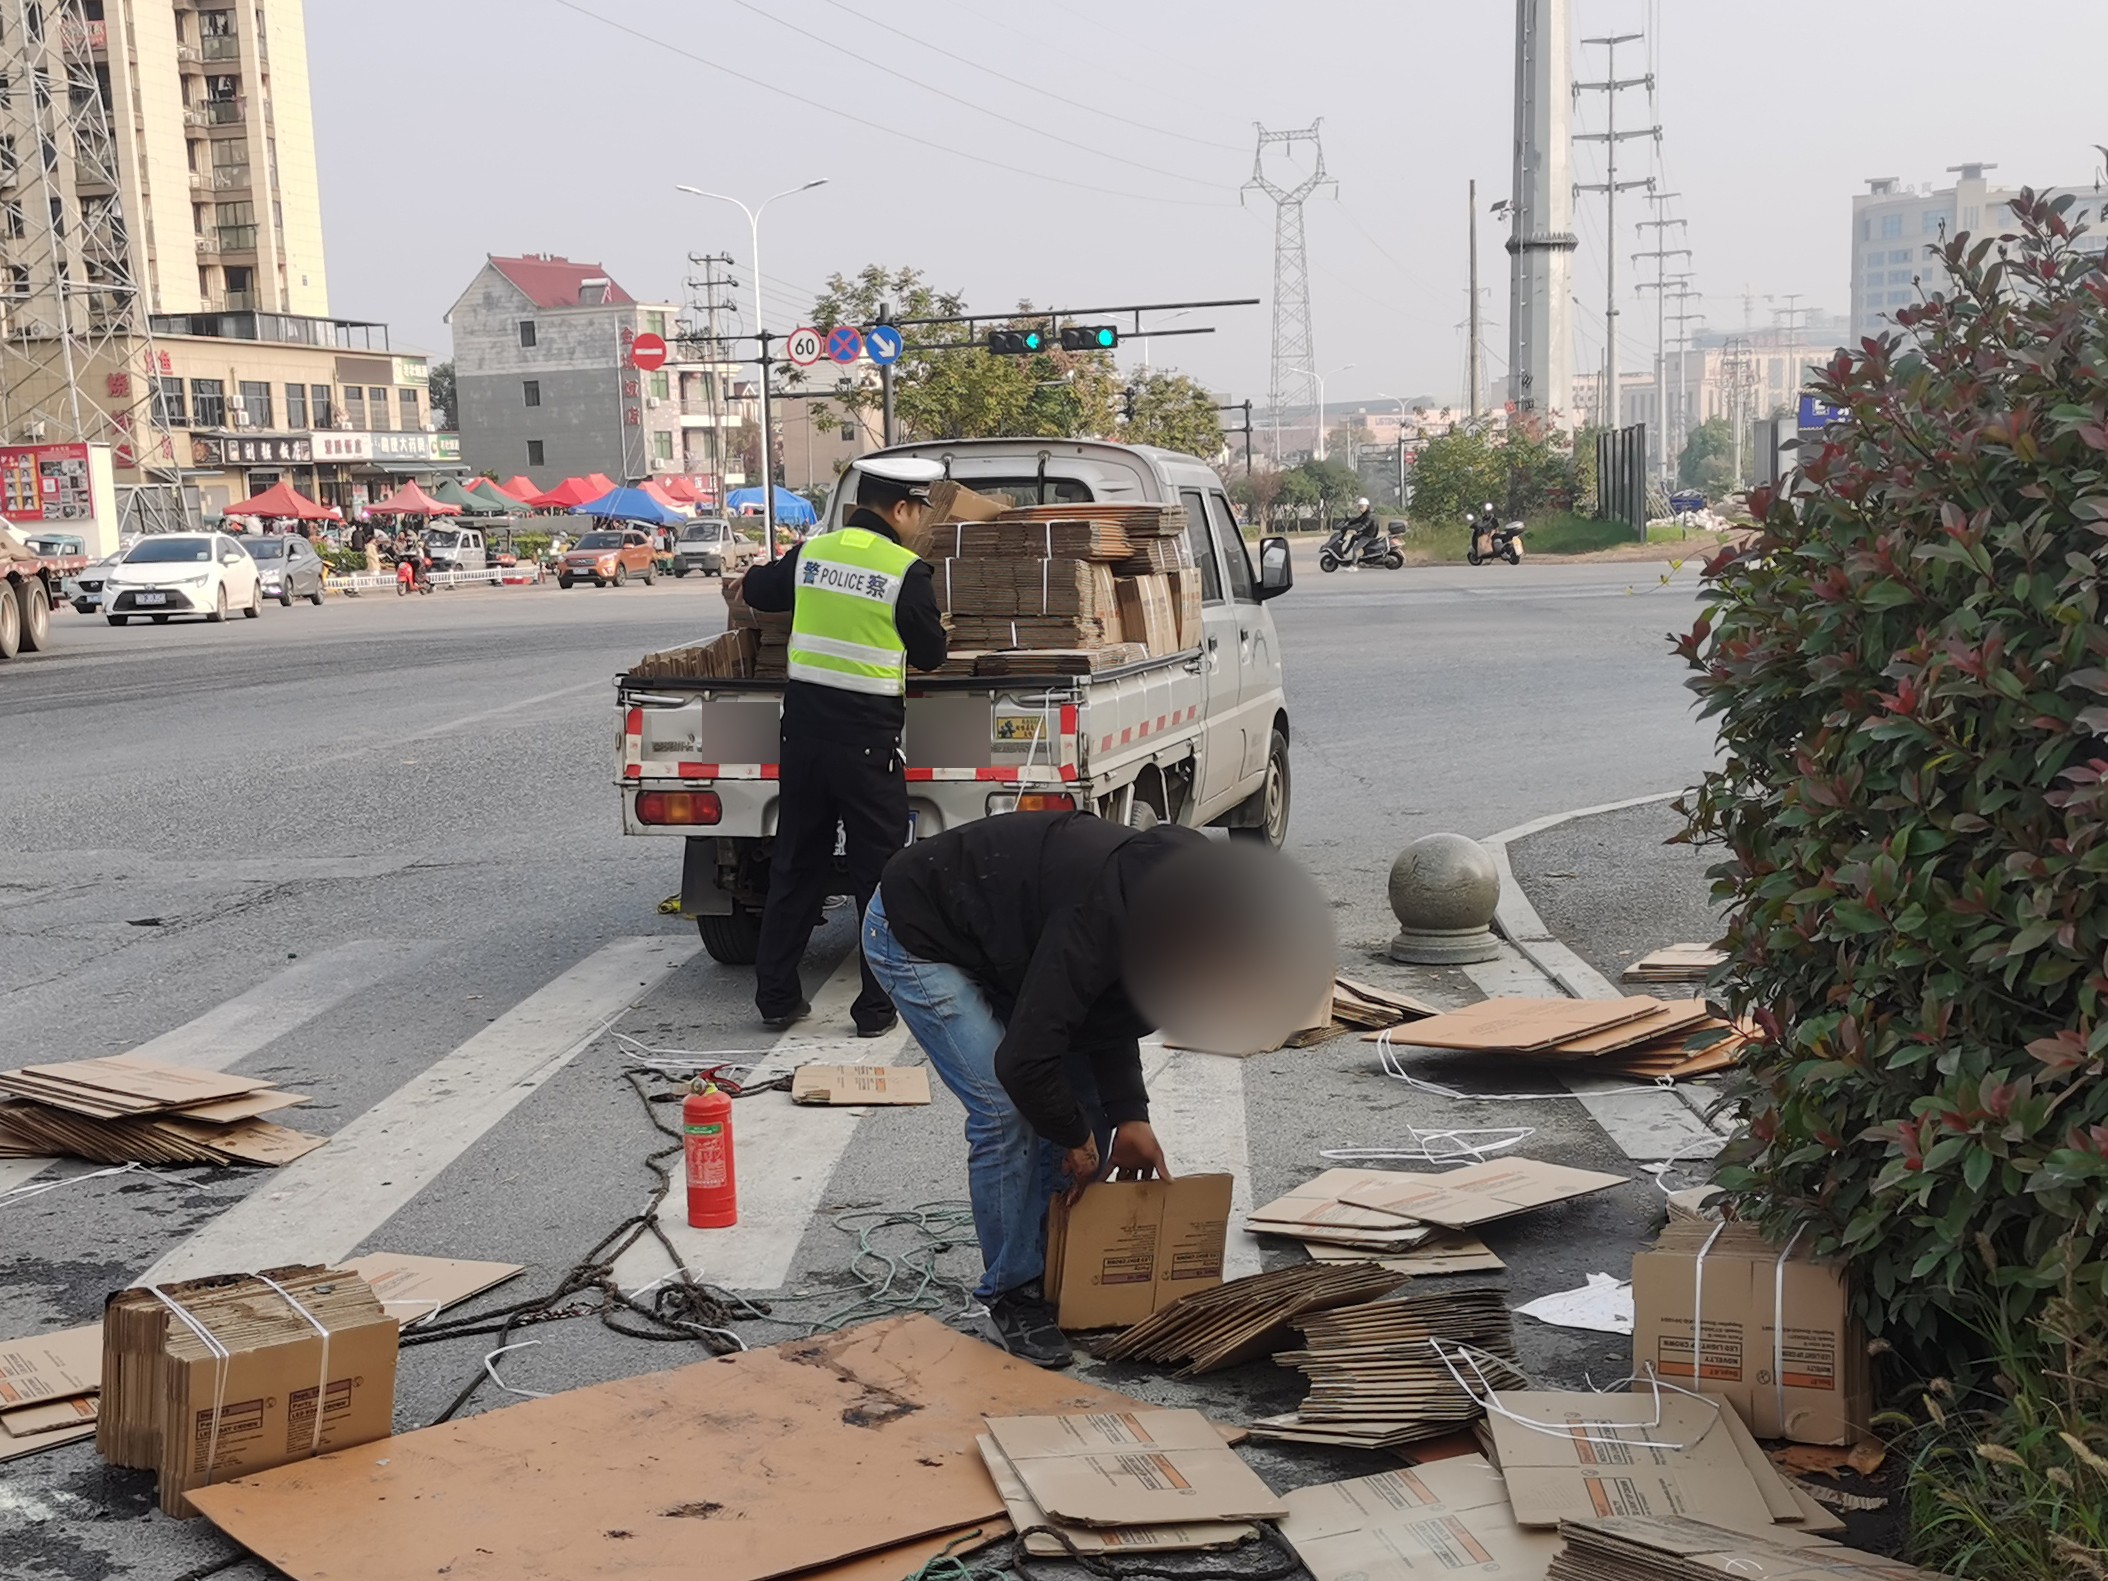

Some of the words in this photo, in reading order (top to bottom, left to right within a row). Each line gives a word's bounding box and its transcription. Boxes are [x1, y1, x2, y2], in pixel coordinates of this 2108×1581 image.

[795, 338, 815, 355] 60
[803, 561, 820, 585] 警
[820, 568, 864, 591] POLICE
[866, 574, 888, 598] 察
[1724, 1344, 1738, 1352] LED
[1704, 1356, 1738, 1365] NOVELTY
